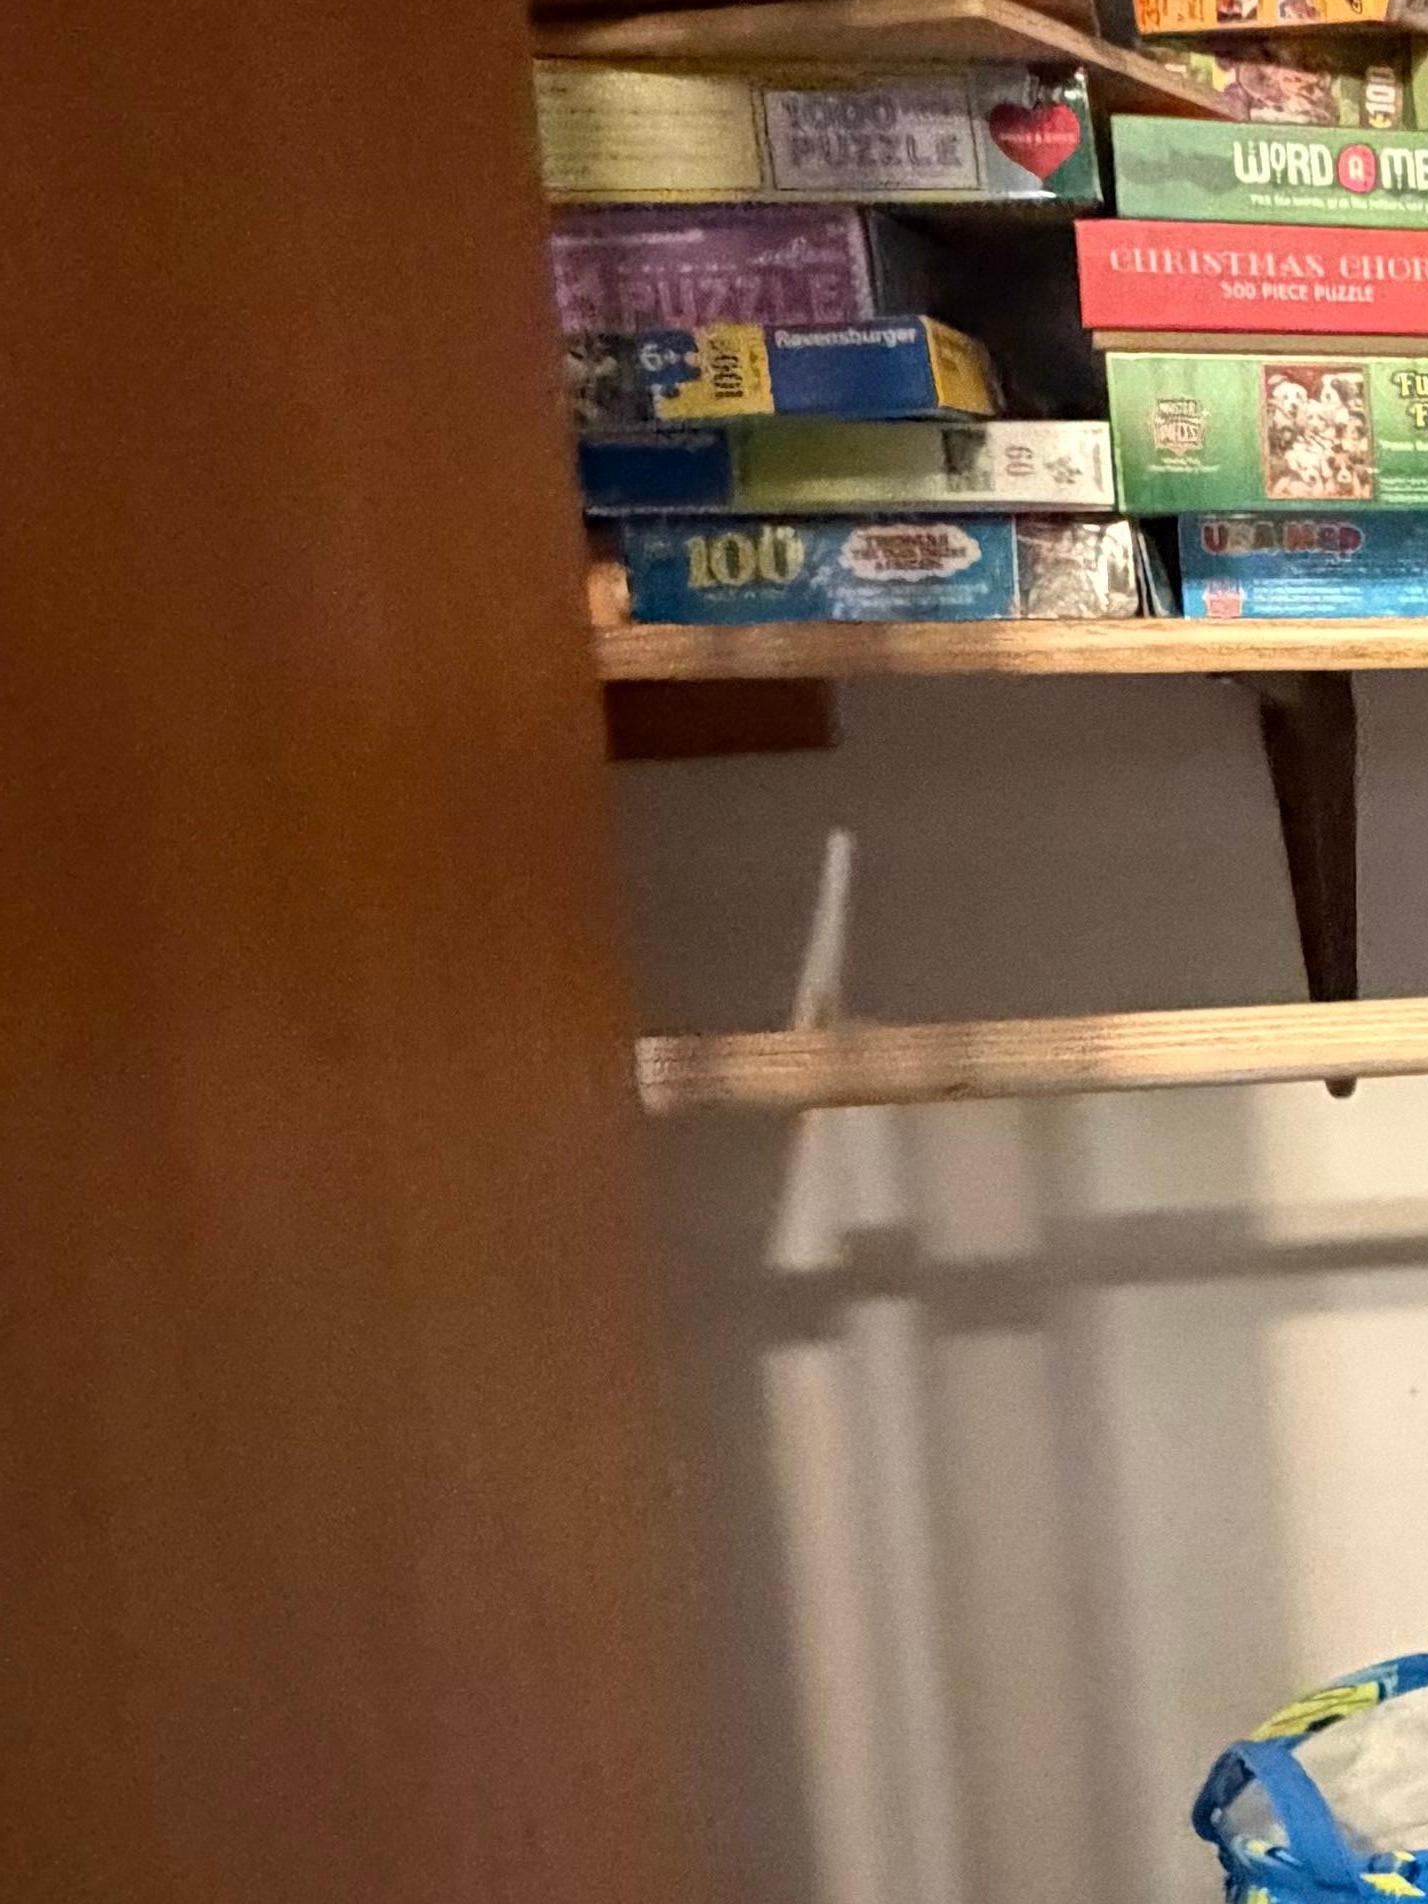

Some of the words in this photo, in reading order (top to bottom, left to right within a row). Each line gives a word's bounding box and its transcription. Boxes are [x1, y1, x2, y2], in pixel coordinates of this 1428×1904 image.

[1232, 140, 1333, 188] WORD
[1108, 246, 1326, 280] CHRISTMAS
[1261, 282, 1308, 302] PIECE
[1313, 283, 1375, 304] PUZZLE
[773, 326, 917, 350] Ravensburger
[686, 525, 804, 589] 100
